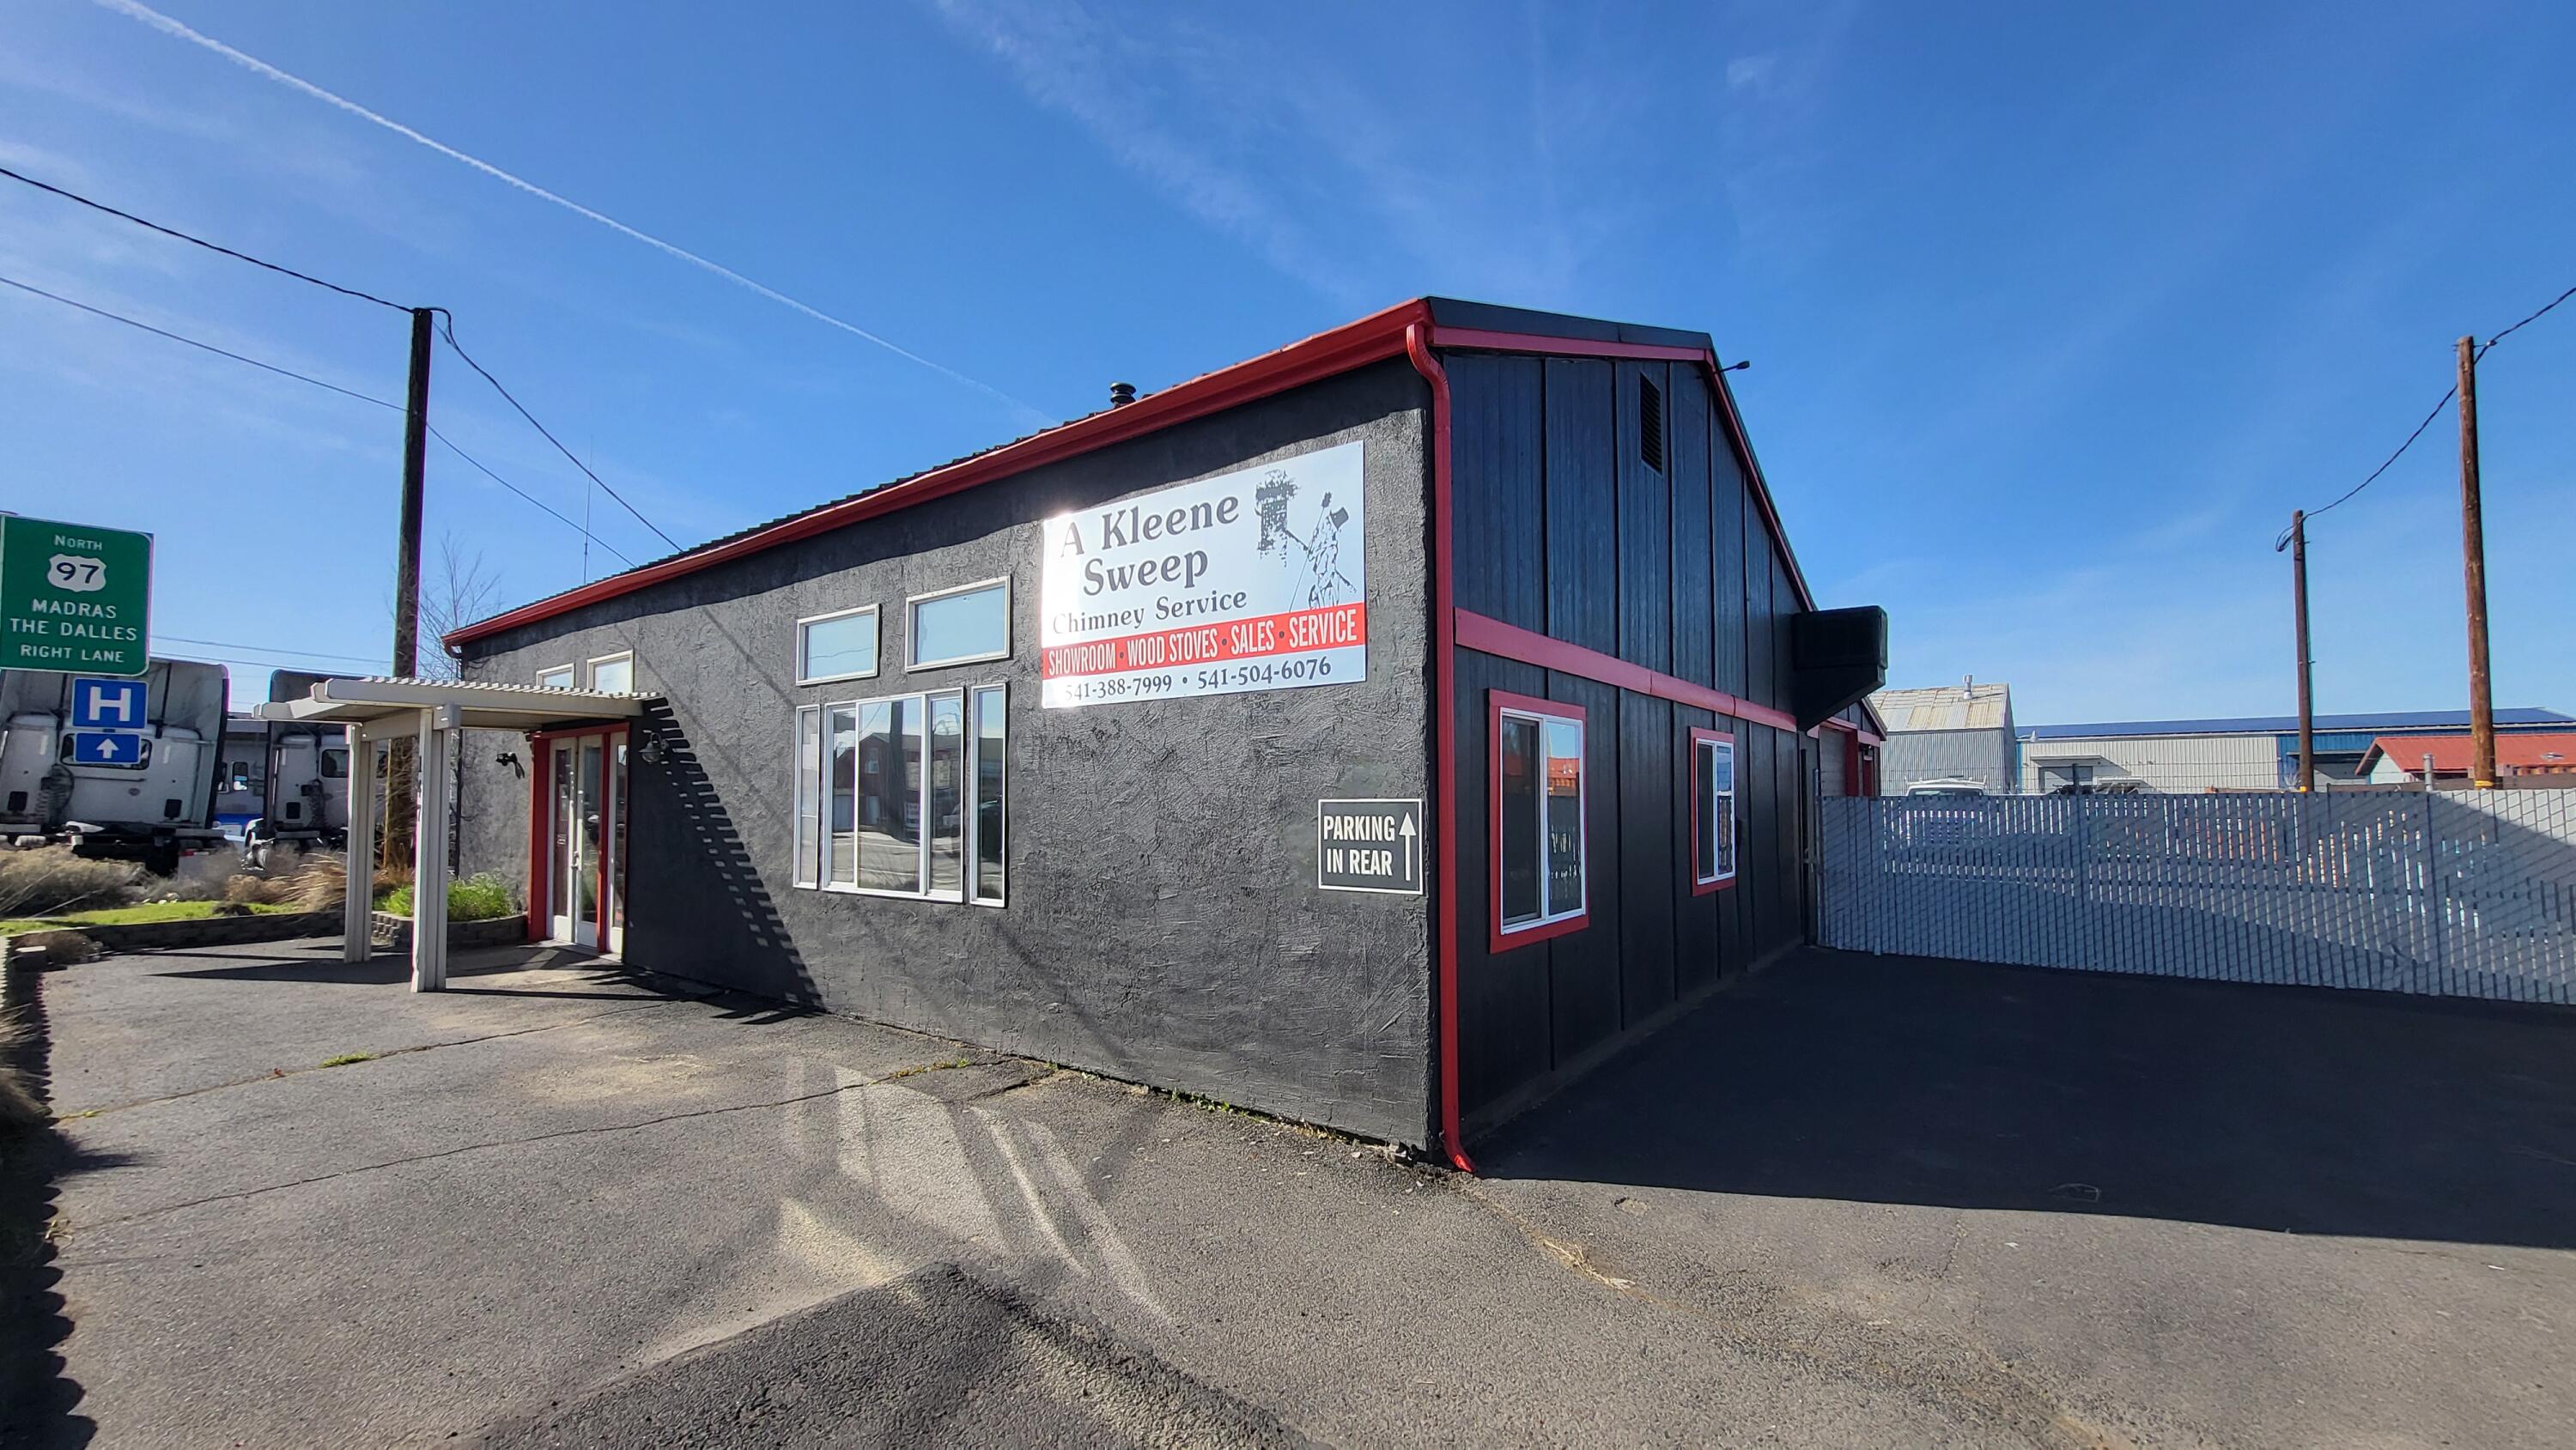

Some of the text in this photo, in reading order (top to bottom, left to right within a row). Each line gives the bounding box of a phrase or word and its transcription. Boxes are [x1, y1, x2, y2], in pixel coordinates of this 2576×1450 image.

[1060, 494, 1239, 558] A Kleene
[54, 534, 102, 550] NORTH
[56, 561, 100, 584] 97
[1083, 548, 1209, 596] Sweep
[32, 598, 117, 619] MADRAS
[1052, 590, 1248, 634] Chimney Service
[10, 618, 137, 641] THE DALLES
[1048, 609, 1358, 676] SHOWROOM WOOD STOVES SALES SERVICE
[21, 645, 125, 663] RIGHT LANE
[1065, 656, 1332, 701] 541-388-7999 541-504-6076
[88, 686, 131, 722] H
[1323, 816, 1395, 841] PARKING
[1327, 848, 1393, 876] IN REAR
